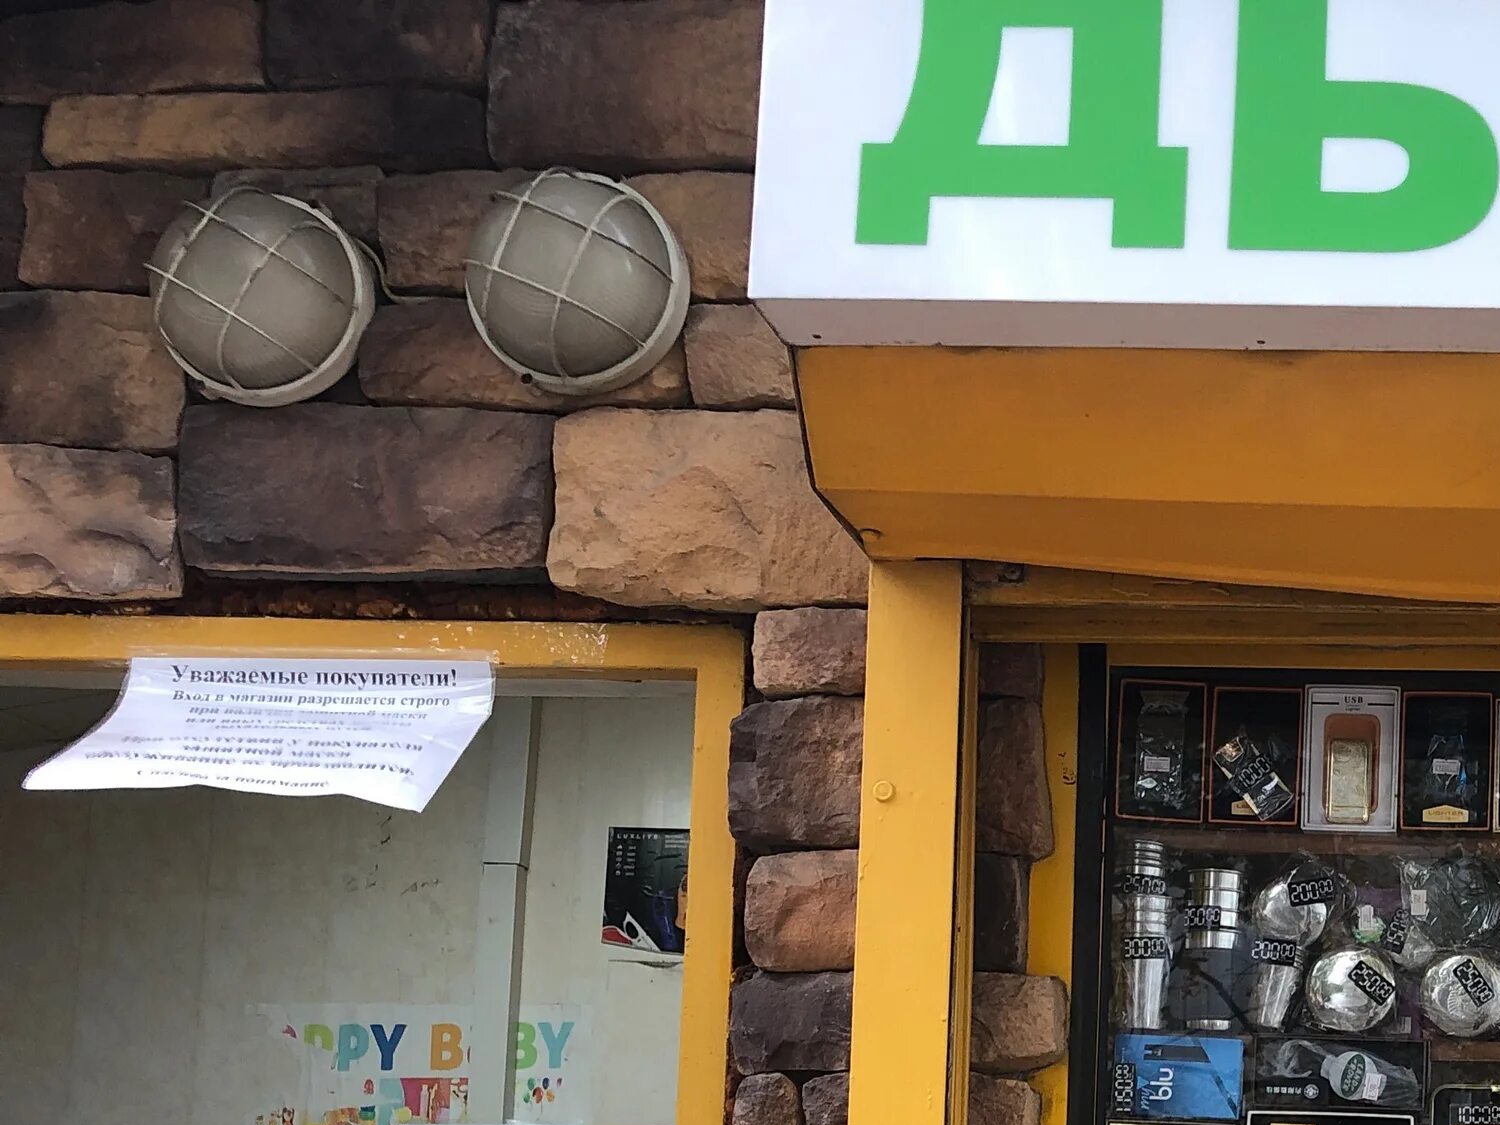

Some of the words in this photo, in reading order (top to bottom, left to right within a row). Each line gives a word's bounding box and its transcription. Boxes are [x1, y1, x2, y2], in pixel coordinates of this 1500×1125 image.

[171, 664, 308, 685] Уважаемые
[316, 668, 457, 691] покупатели!
[172, 690, 209, 702] Вход
[215, 694, 224, 702] в
[229, 693, 293, 704] магазин
[297, 694, 395, 707] разрешается
[400, 697, 450, 708] строго
[1344, 695, 1364, 704] USB
[1291, 879, 1334, 902] 20000
[1124, 938, 1165, 957] 30000
[1251, 941, 1295, 961] 20000
[1350, 964, 1393, 1000] 25000
[1457, 962, 1493, 1003] 25000
[1150, 1067, 1174, 1100] blu
